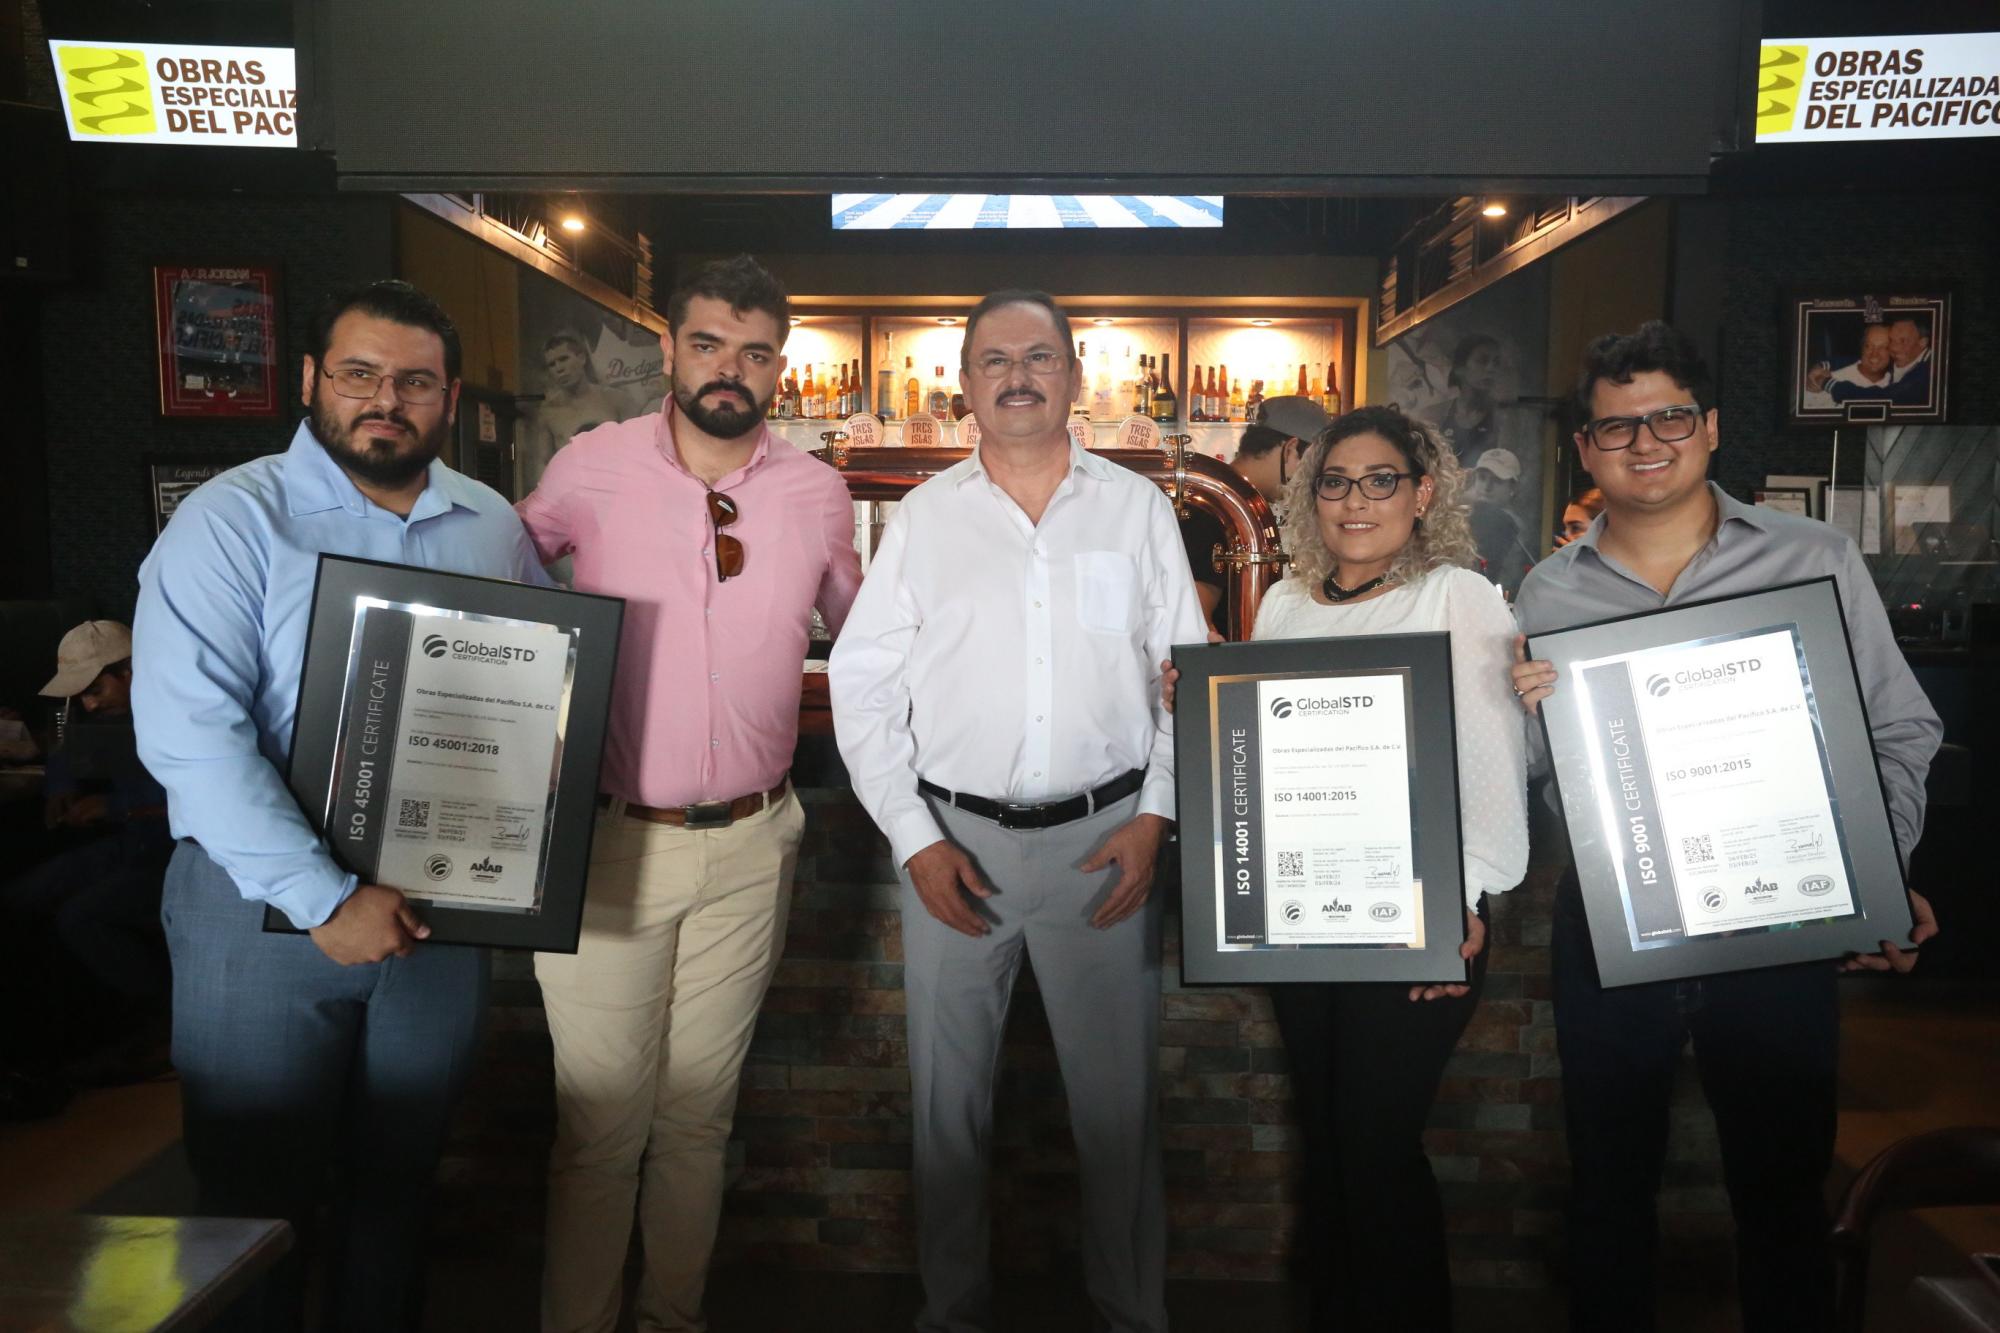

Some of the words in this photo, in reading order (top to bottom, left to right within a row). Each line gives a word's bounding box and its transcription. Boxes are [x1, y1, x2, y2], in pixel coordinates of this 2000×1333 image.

[156, 57, 266, 85] OBRAS
[1814, 48, 1924, 77] OBRAS
[1809, 75, 2000, 101] ESPECIALIZADA
[165, 108, 227, 134] DEL
[1804, 104, 1862, 130] DEL
[850, 423, 873, 436] TRES
[911, 423, 932, 434] TRES
[911, 434, 932, 444] ISLAS
[1130, 424, 1151, 437] TRES
[852, 435, 874, 446] ISLAS
[1126, 436, 1150, 448] ISLAS
[452, 640, 536, 662] GlobalSTD
[452, 654, 508, 666] CERTIFICATION
[1674, 658, 1762, 685] GlobalSTD
[416, 688, 436, 696] Obras
[1296, 696, 1374, 710] GlobalSTD
[362, 659, 390, 756] CERTIFICATE
[1298, 710, 1350, 718] CERTIFICATION
[408, 736, 430, 747] ISO
[432, 738, 500, 755] 45001:2018
[1232, 728, 1248, 816] CERTIFICATE
[1608, 718, 1642, 811] CERTIFICATE
[1666, 769, 1686, 782] ISO
[1690, 758, 1752, 778] 9001:2015
[354, 760, 375, 809] 45001
[1274, 792, 1292, 802] ISO
[1296, 790, 1357, 802] 14001:2015
[350, 812, 366, 841] ISO
[1630, 815, 1652, 854] 9001
[1235, 821, 1250, 864] 14001
[470, 862, 503, 874] ANAB
[1638, 858, 1657, 886] ISO
[1236, 868, 1250, 896] ISO
[1744, 883, 1778, 895] ANAB
[1805, 880, 1830, 892] IAF
[1322, 904, 1352, 912] ANAB
[1374, 908, 1396, 917] IAF
